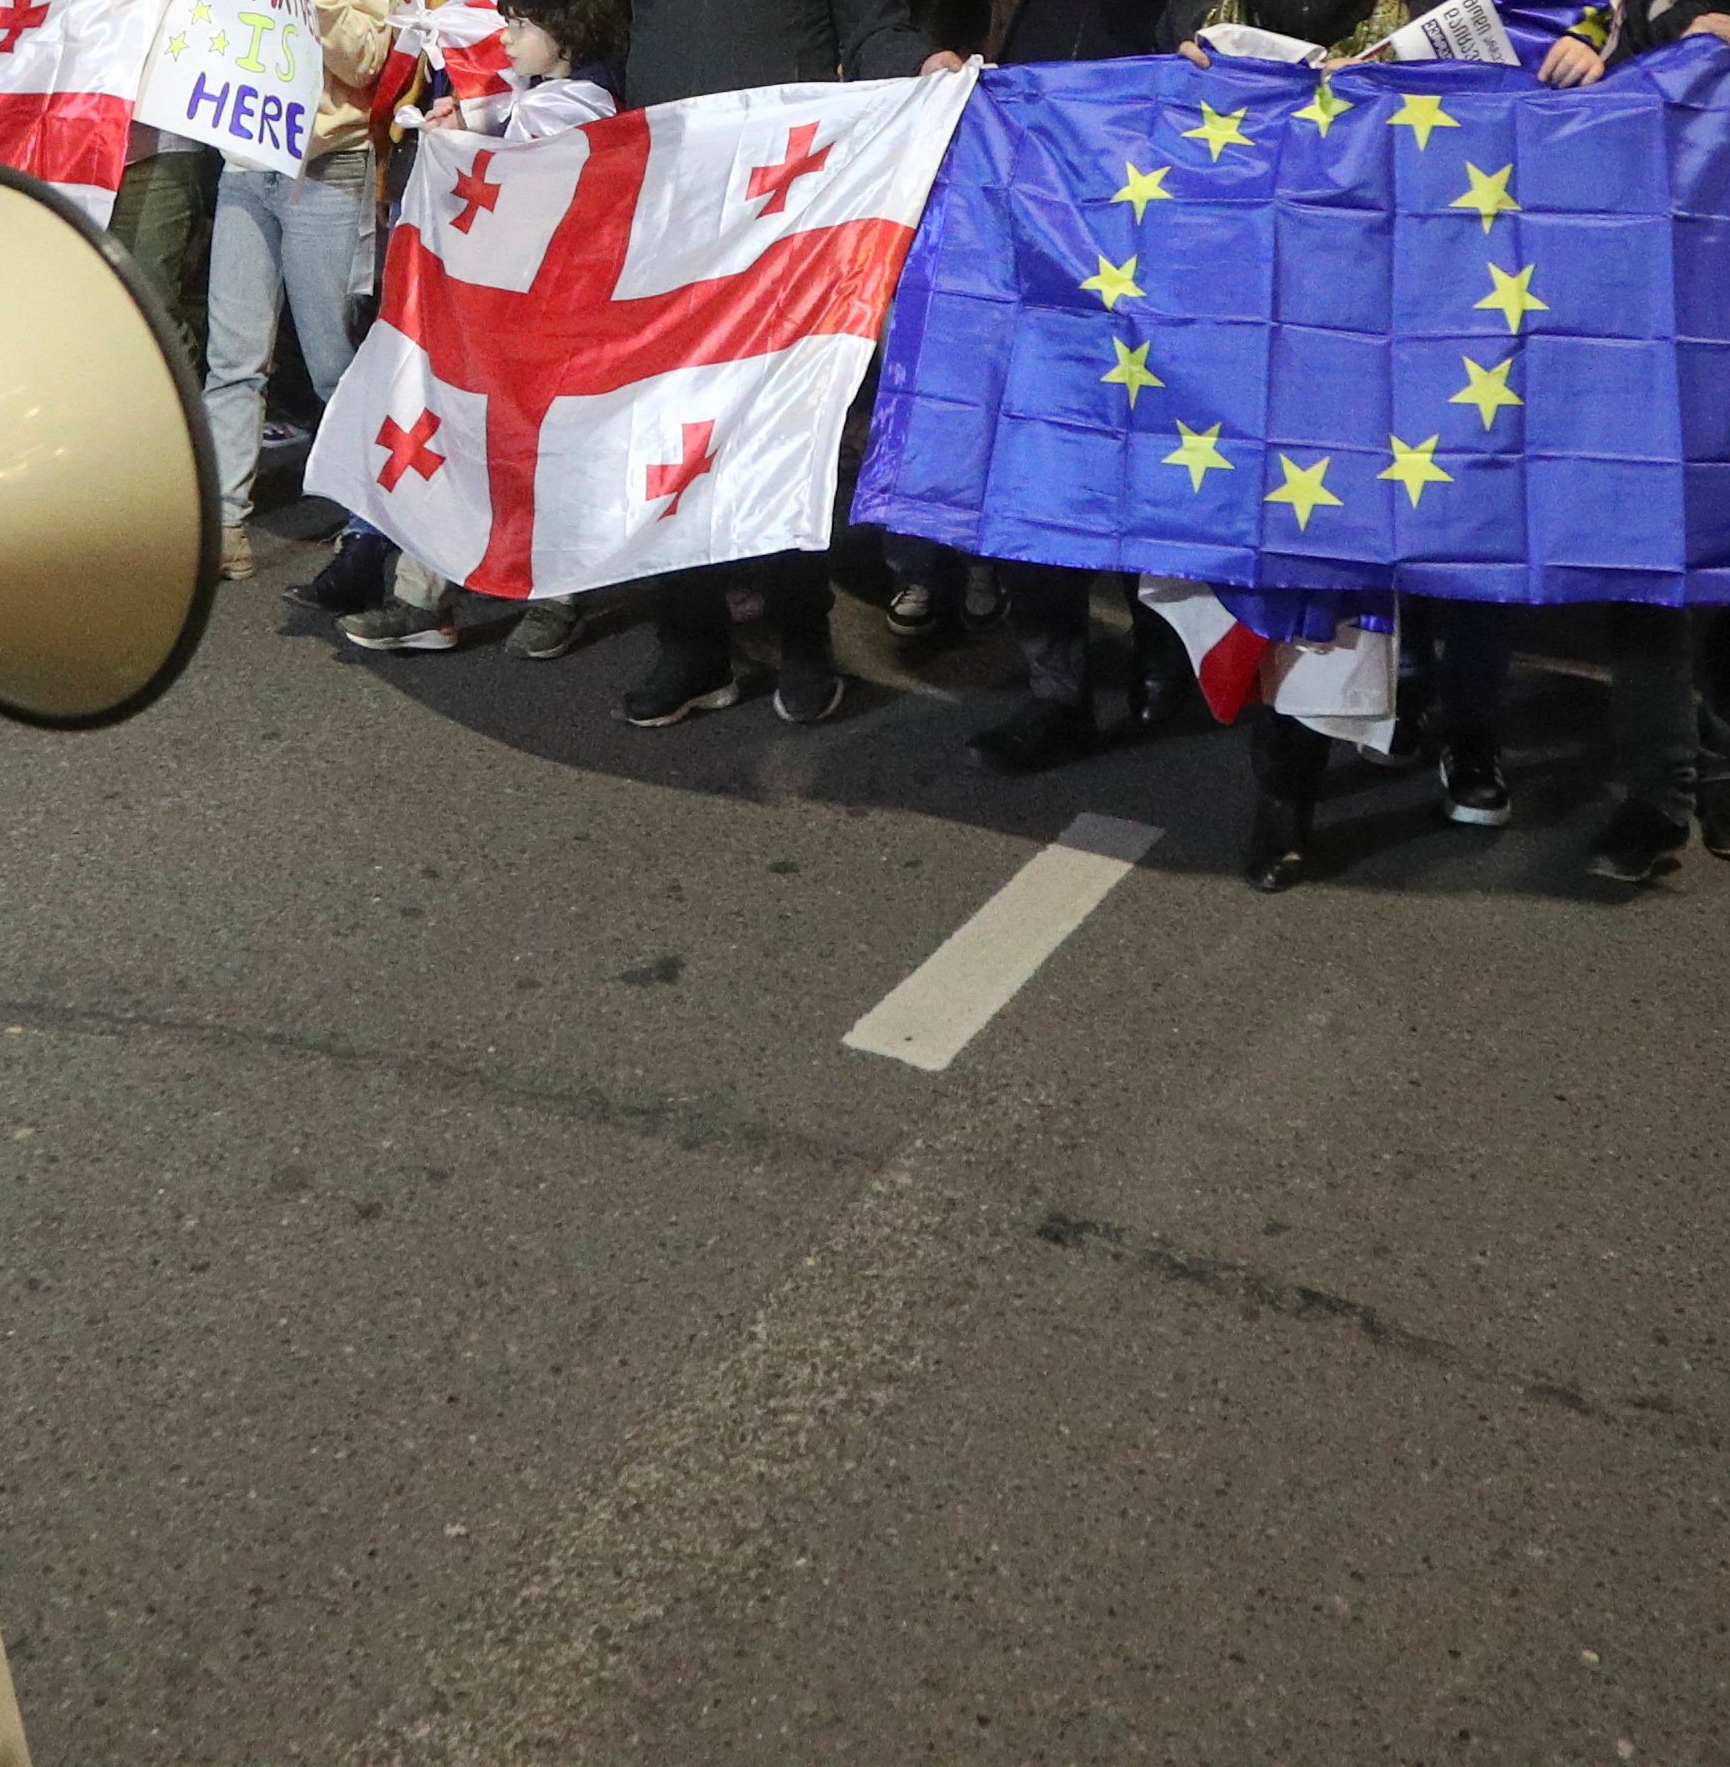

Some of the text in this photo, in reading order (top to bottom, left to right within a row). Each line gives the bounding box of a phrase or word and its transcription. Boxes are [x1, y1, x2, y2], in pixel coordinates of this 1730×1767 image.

[235, 11, 299, 83] IS
[1444, 8, 1483, 61] დაიცავ
[186, 72, 306, 160] HERE
